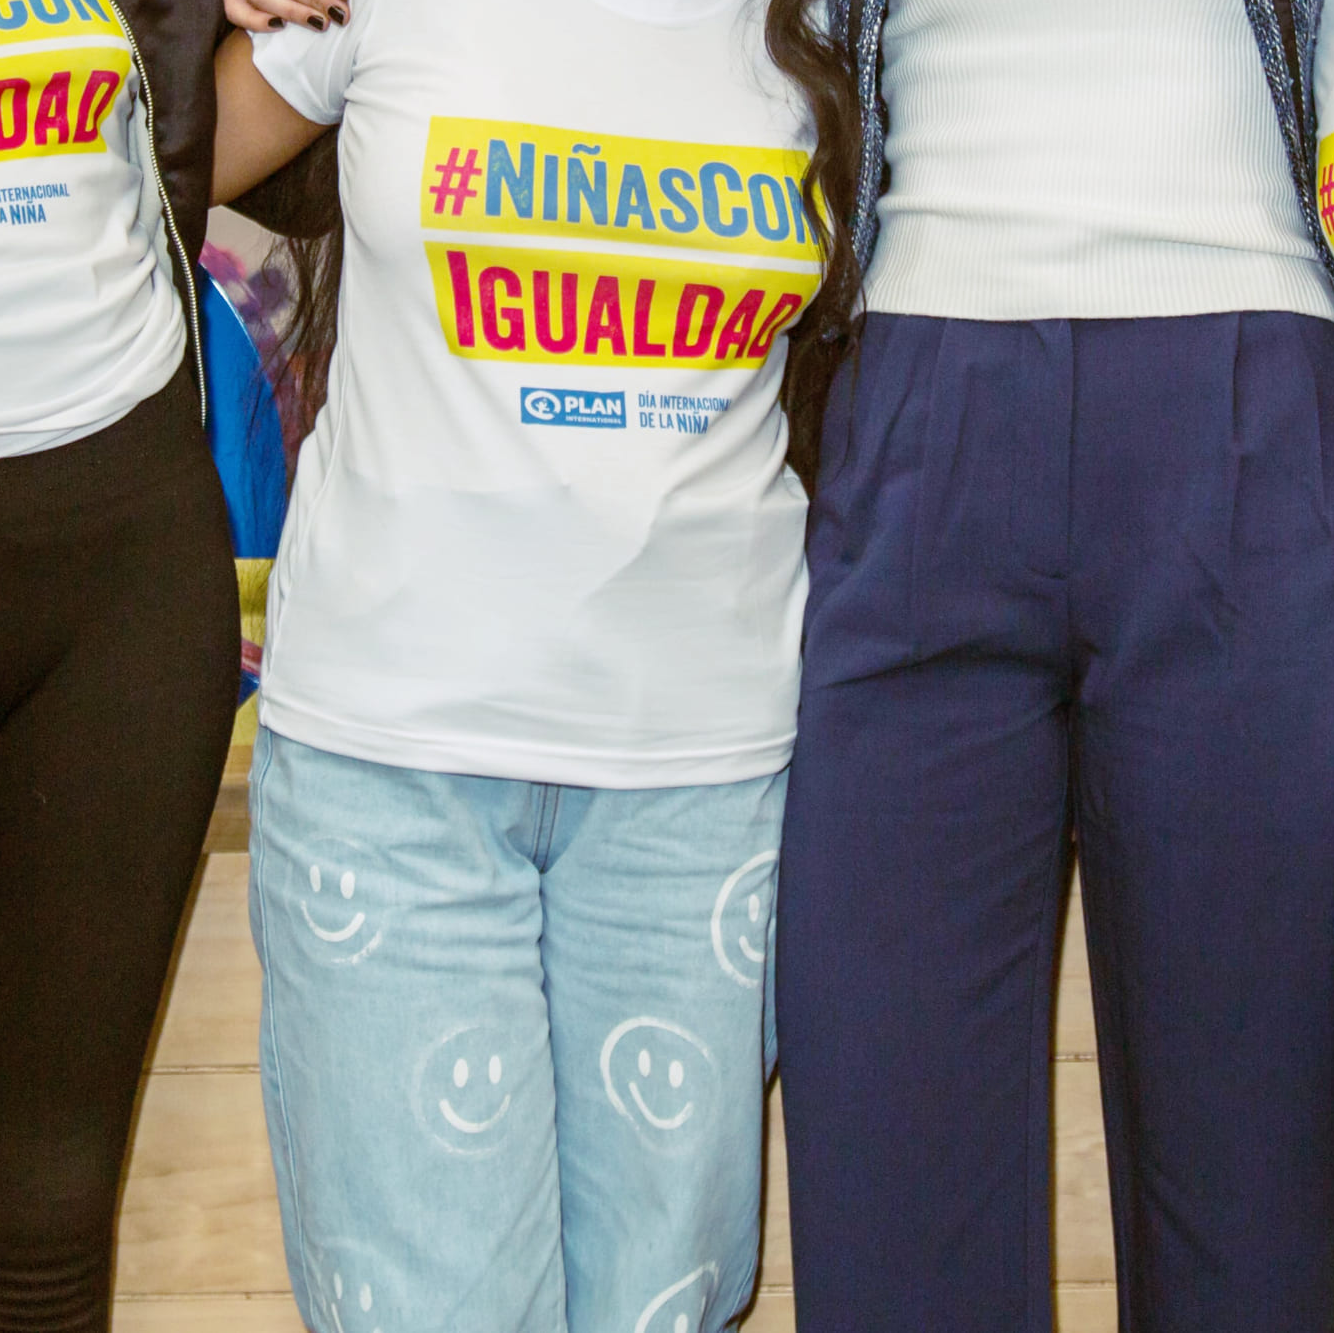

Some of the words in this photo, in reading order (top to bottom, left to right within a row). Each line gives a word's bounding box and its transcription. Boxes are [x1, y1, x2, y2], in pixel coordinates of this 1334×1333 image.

[10, 201, 47, 226] NIÑA
[446, 250, 803, 360] IGUALDAD
[564, 396, 622, 416] PLAN
[638, 390, 657, 409] DÍA
[660, 395, 732, 412] INTERNACIONA
[565, 415, 623, 425] INTERNATIONAL
[639, 413, 656, 429] DE
[659, 413, 674, 429] LA
[675, 410, 709, 435] NIÑA
